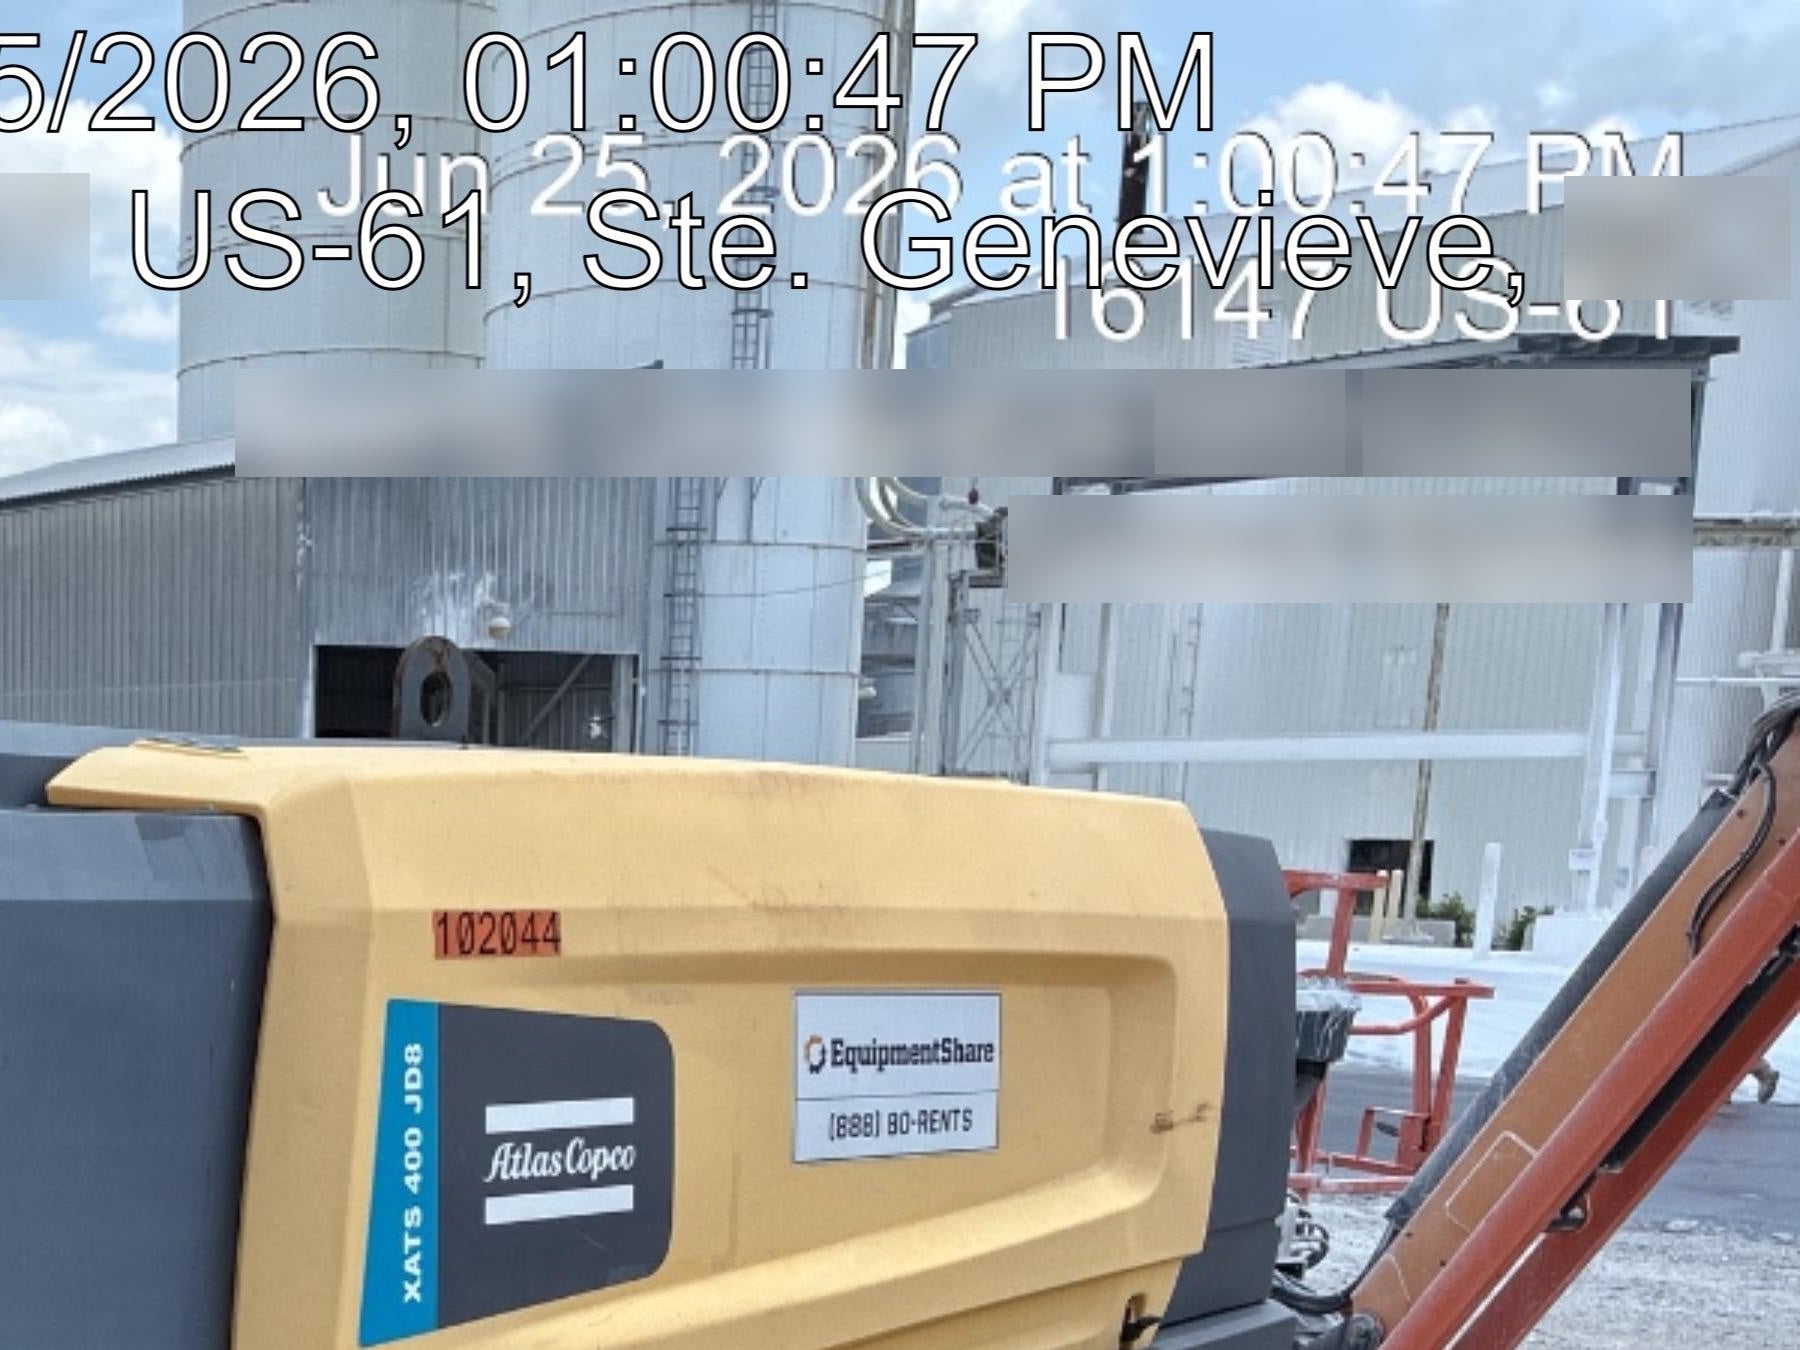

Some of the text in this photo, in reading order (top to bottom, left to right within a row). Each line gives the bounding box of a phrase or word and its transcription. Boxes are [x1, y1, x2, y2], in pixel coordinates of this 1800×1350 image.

[437, 911, 562, 956] 102044
[830, 1036, 995, 1075] EquipmentShare
[403, 1042, 423, 1304] XATS 400 JD8
[483, 1135, 638, 1183] Atlas Copco
